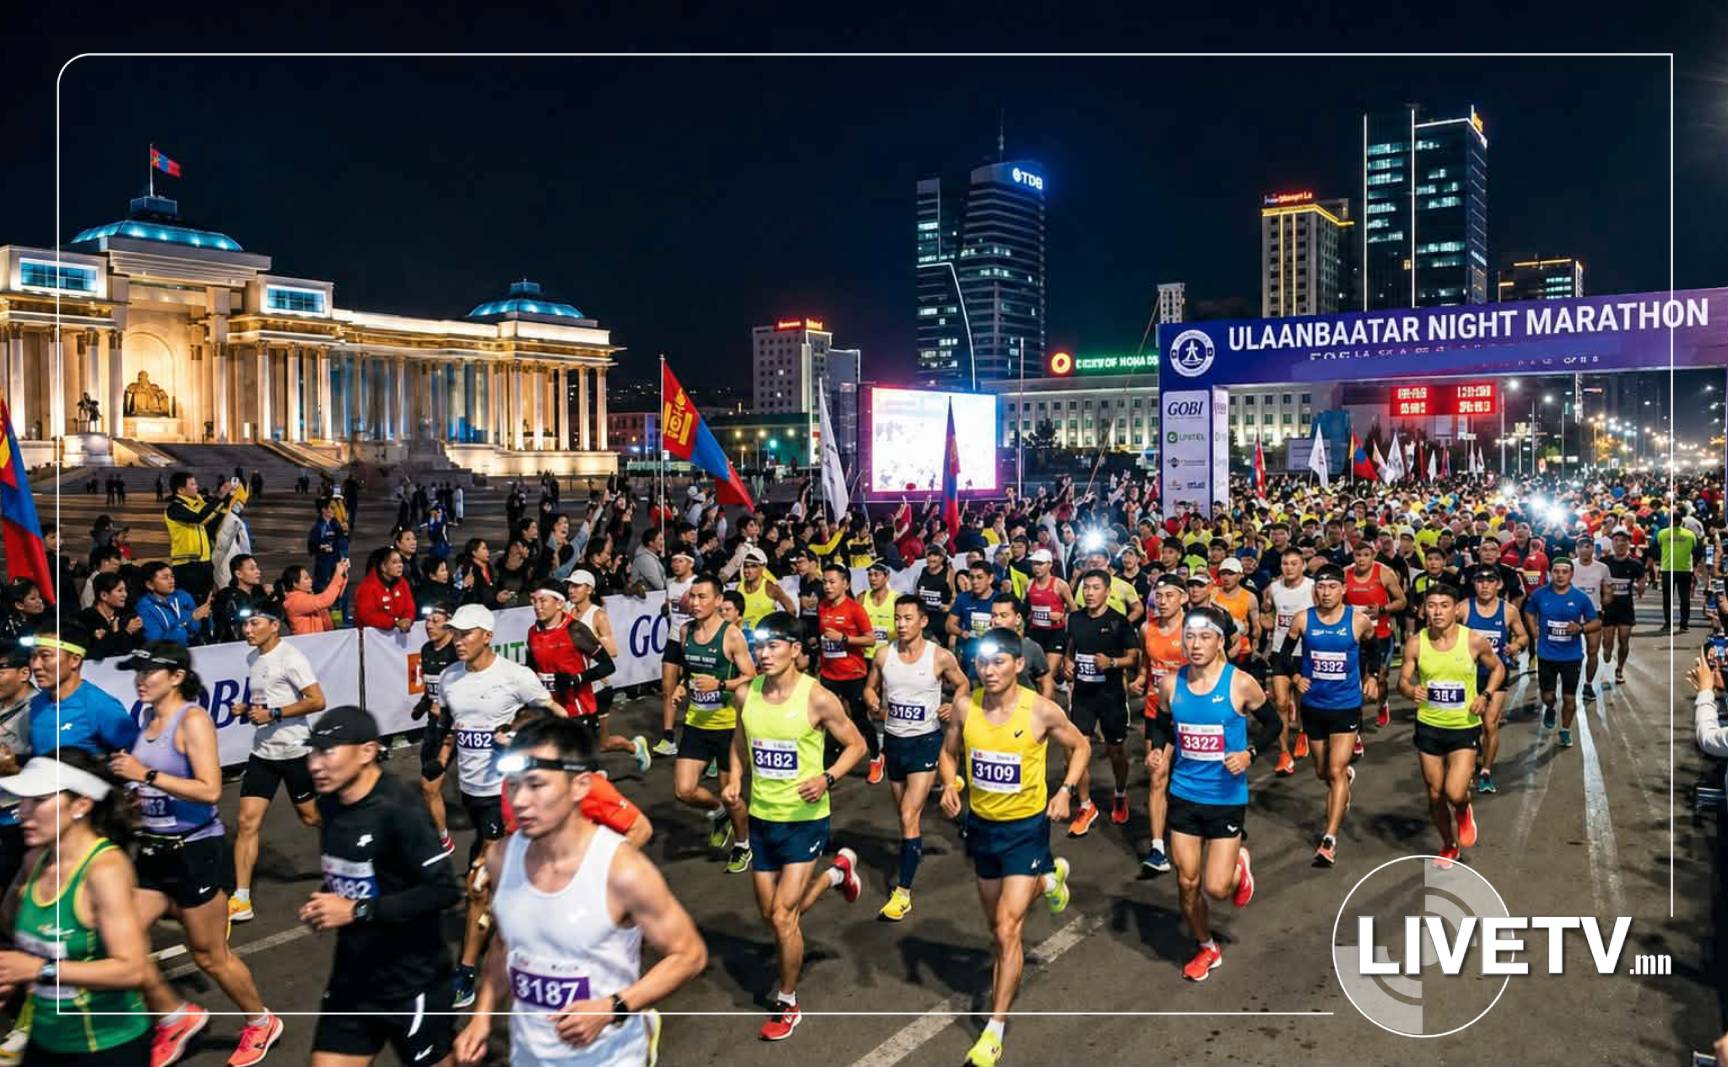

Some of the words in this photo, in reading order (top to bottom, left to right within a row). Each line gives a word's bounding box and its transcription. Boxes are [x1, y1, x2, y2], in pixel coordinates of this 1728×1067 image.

[1228, 316, 1420, 351] ULAANBAATAR
[1428, 310, 1518, 342] NIGHT
[1526, 298, 1709, 336] MARATHON
[1167, 401, 1203, 416] GOBI
[457, 731, 492, 748] 3182
[1183, 735, 1219, 751] 3322
[755, 750, 793, 768] 3182
[975, 762, 1015, 782] 3109
[516, 973, 581, 1010] 3187
